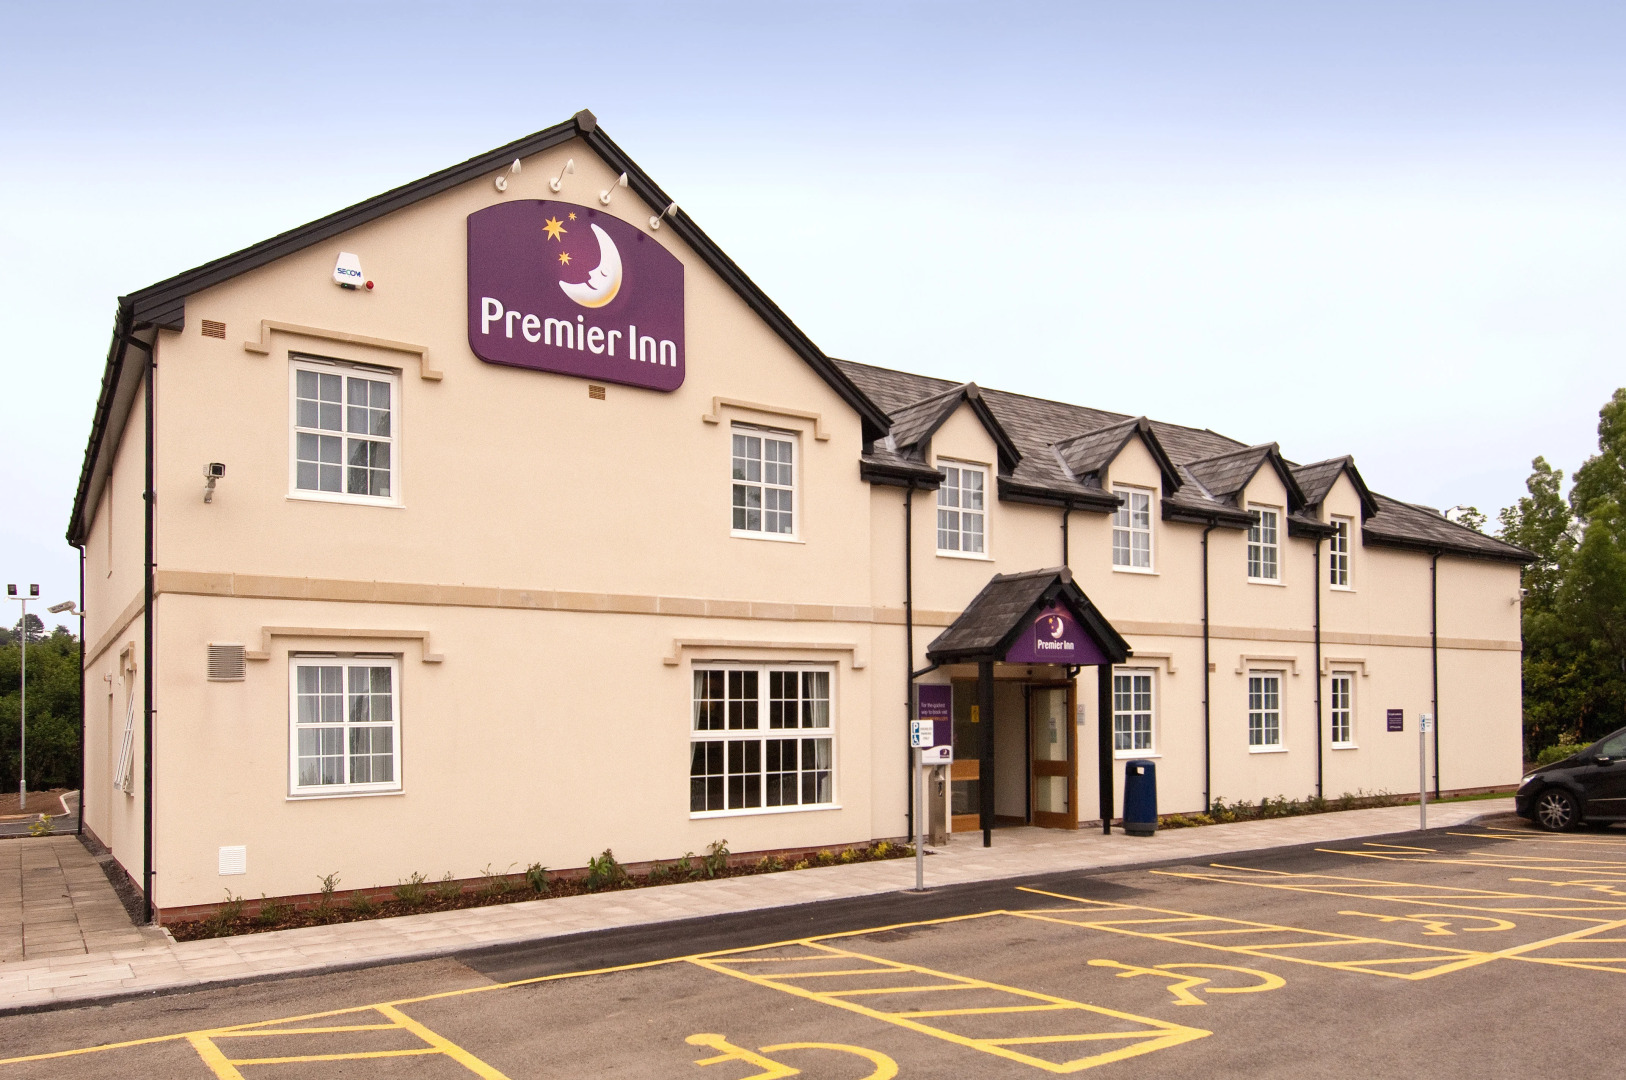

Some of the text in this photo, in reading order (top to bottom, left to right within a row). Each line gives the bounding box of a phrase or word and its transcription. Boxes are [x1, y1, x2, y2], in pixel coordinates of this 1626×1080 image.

[337, 267, 361, 277] SECOM
[481, 296, 677, 367] Premier Inn
[1037, 639, 1074, 650] Premier Inn
